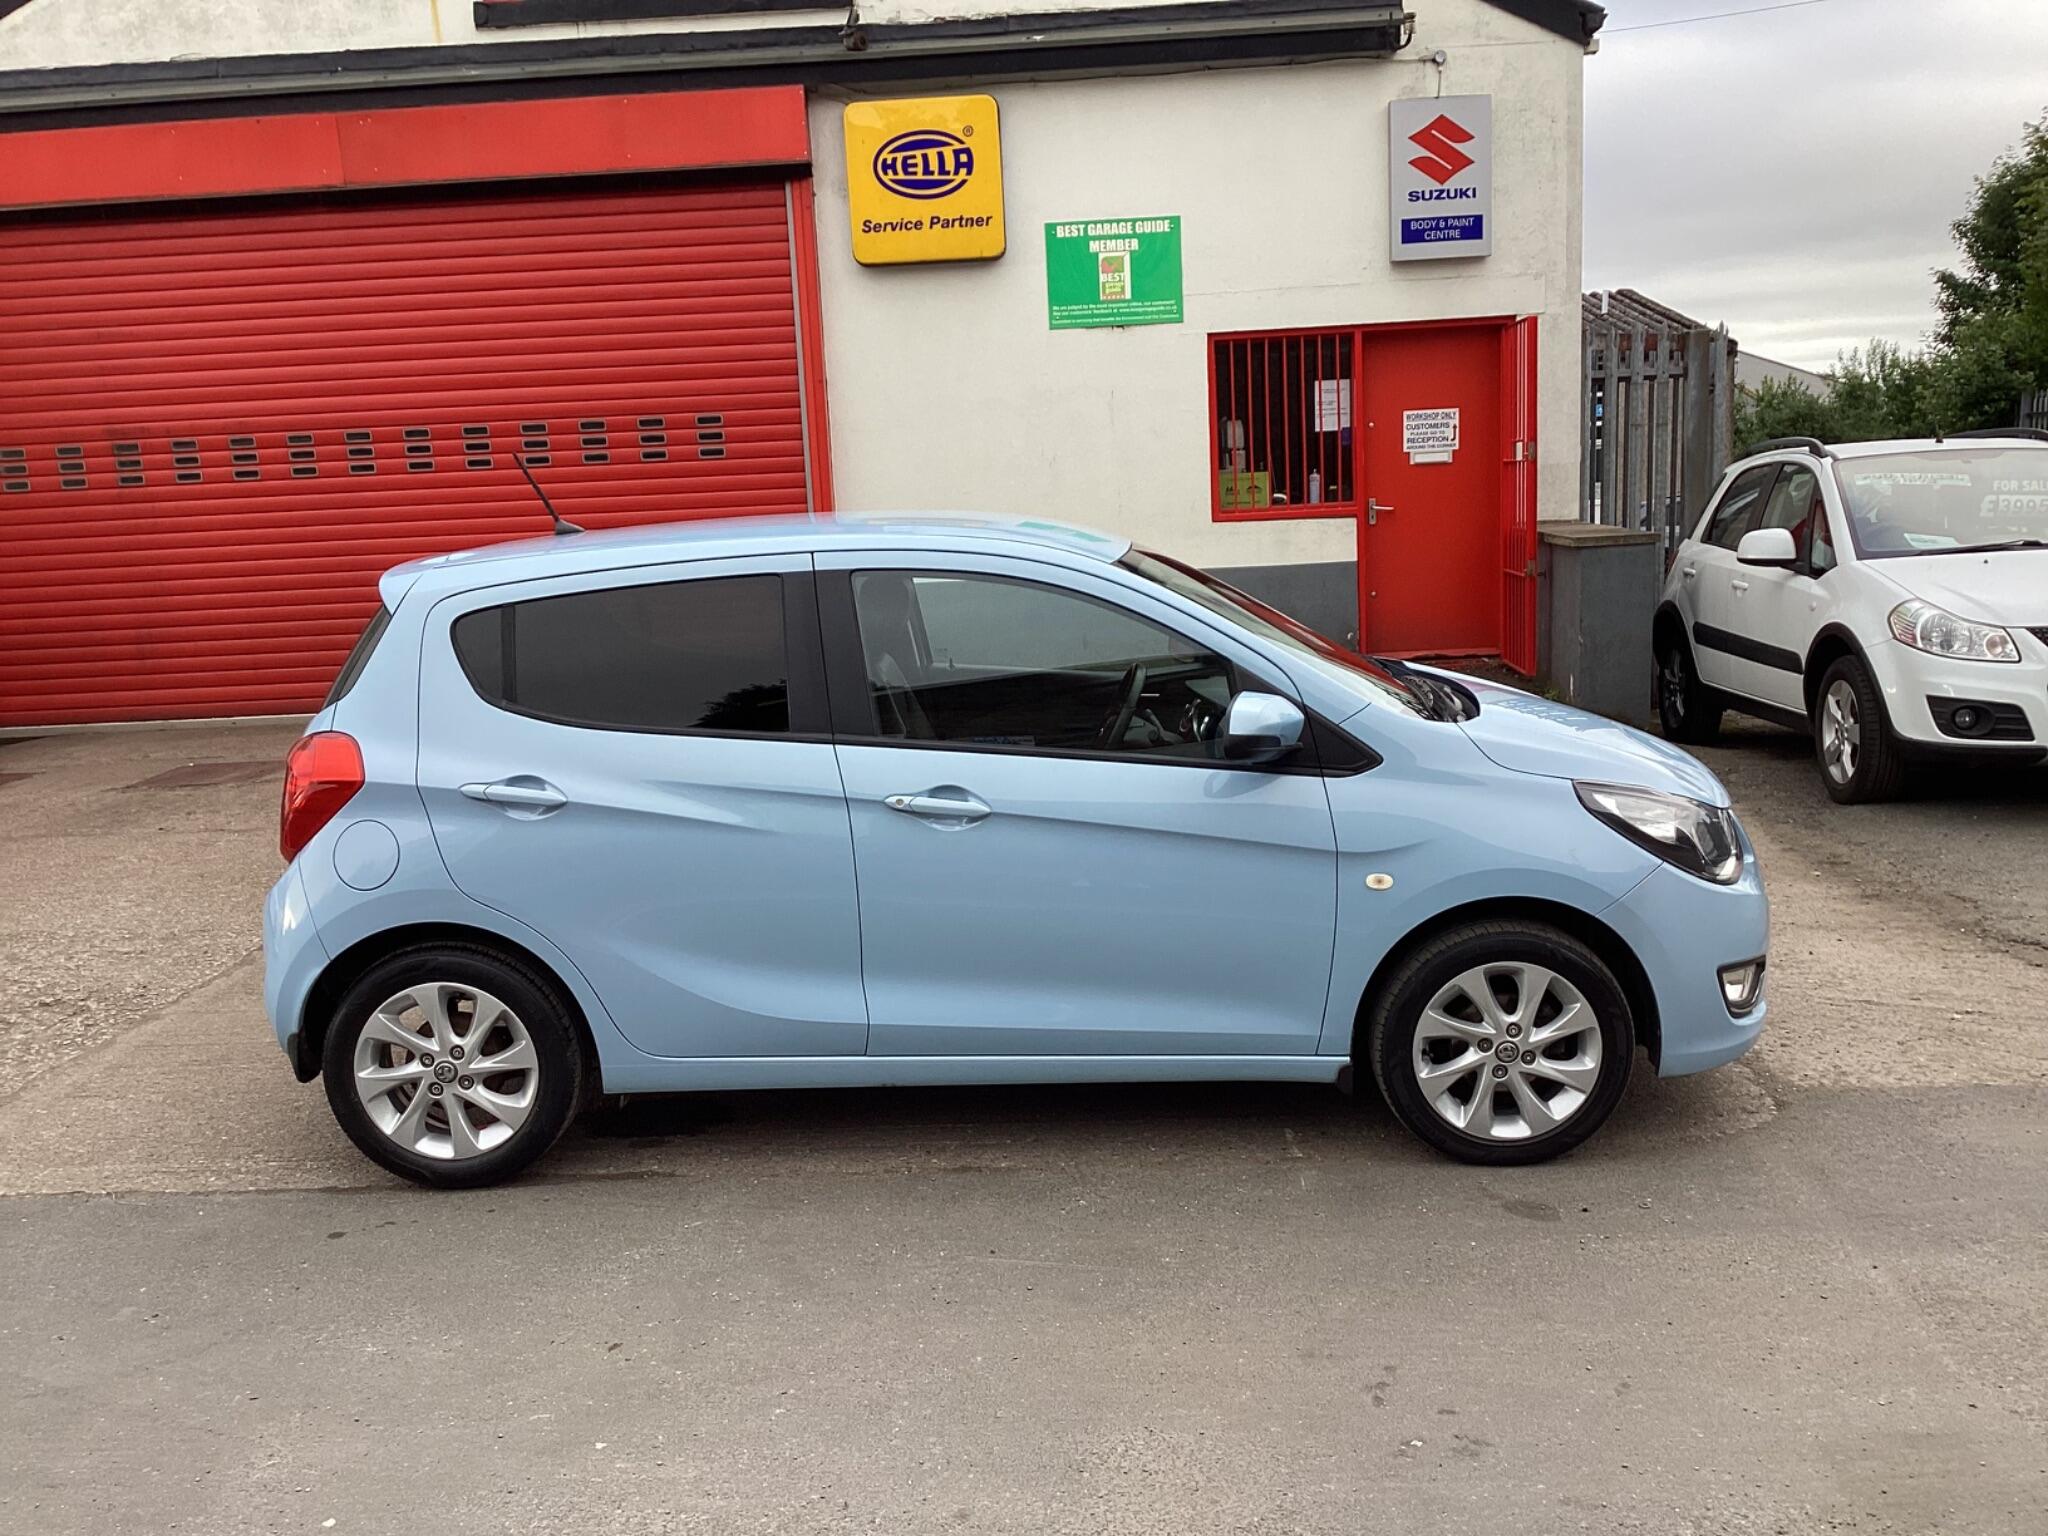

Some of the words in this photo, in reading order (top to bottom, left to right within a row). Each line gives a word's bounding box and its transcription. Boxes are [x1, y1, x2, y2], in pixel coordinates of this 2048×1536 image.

[880, 146, 974, 176] HELLA
[1408, 187, 1477, 203] SUZUKI
[861, 218, 924, 234] Service
[929, 214, 993, 229] Partner
[1056, 224, 1086, 238] BEST
[1087, 222, 1133, 236] GARAGE
[1135, 220, 1171, 233] GUIDE
[1410, 219, 1437, 230] BODY
[1439, 219, 1446, 228] &
[1447, 217, 1474, 227] PAINT
[1424, 229, 1461, 240] CENTRE
[1088, 238, 1139, 253] MEMBER
[1101, 272, 1125, 282] BEST
[1406, 412, 1440, 421] WORKSHOP
[1441, 411, 1457, 420] ONLY
[1406, 422, 1450, 431] CUSTOMERS
[1406, 436, 1449, 444] RECEPTION
[1993, 480, 2018, 491] FOR
[2022, 480, 2048, 491] SAL
